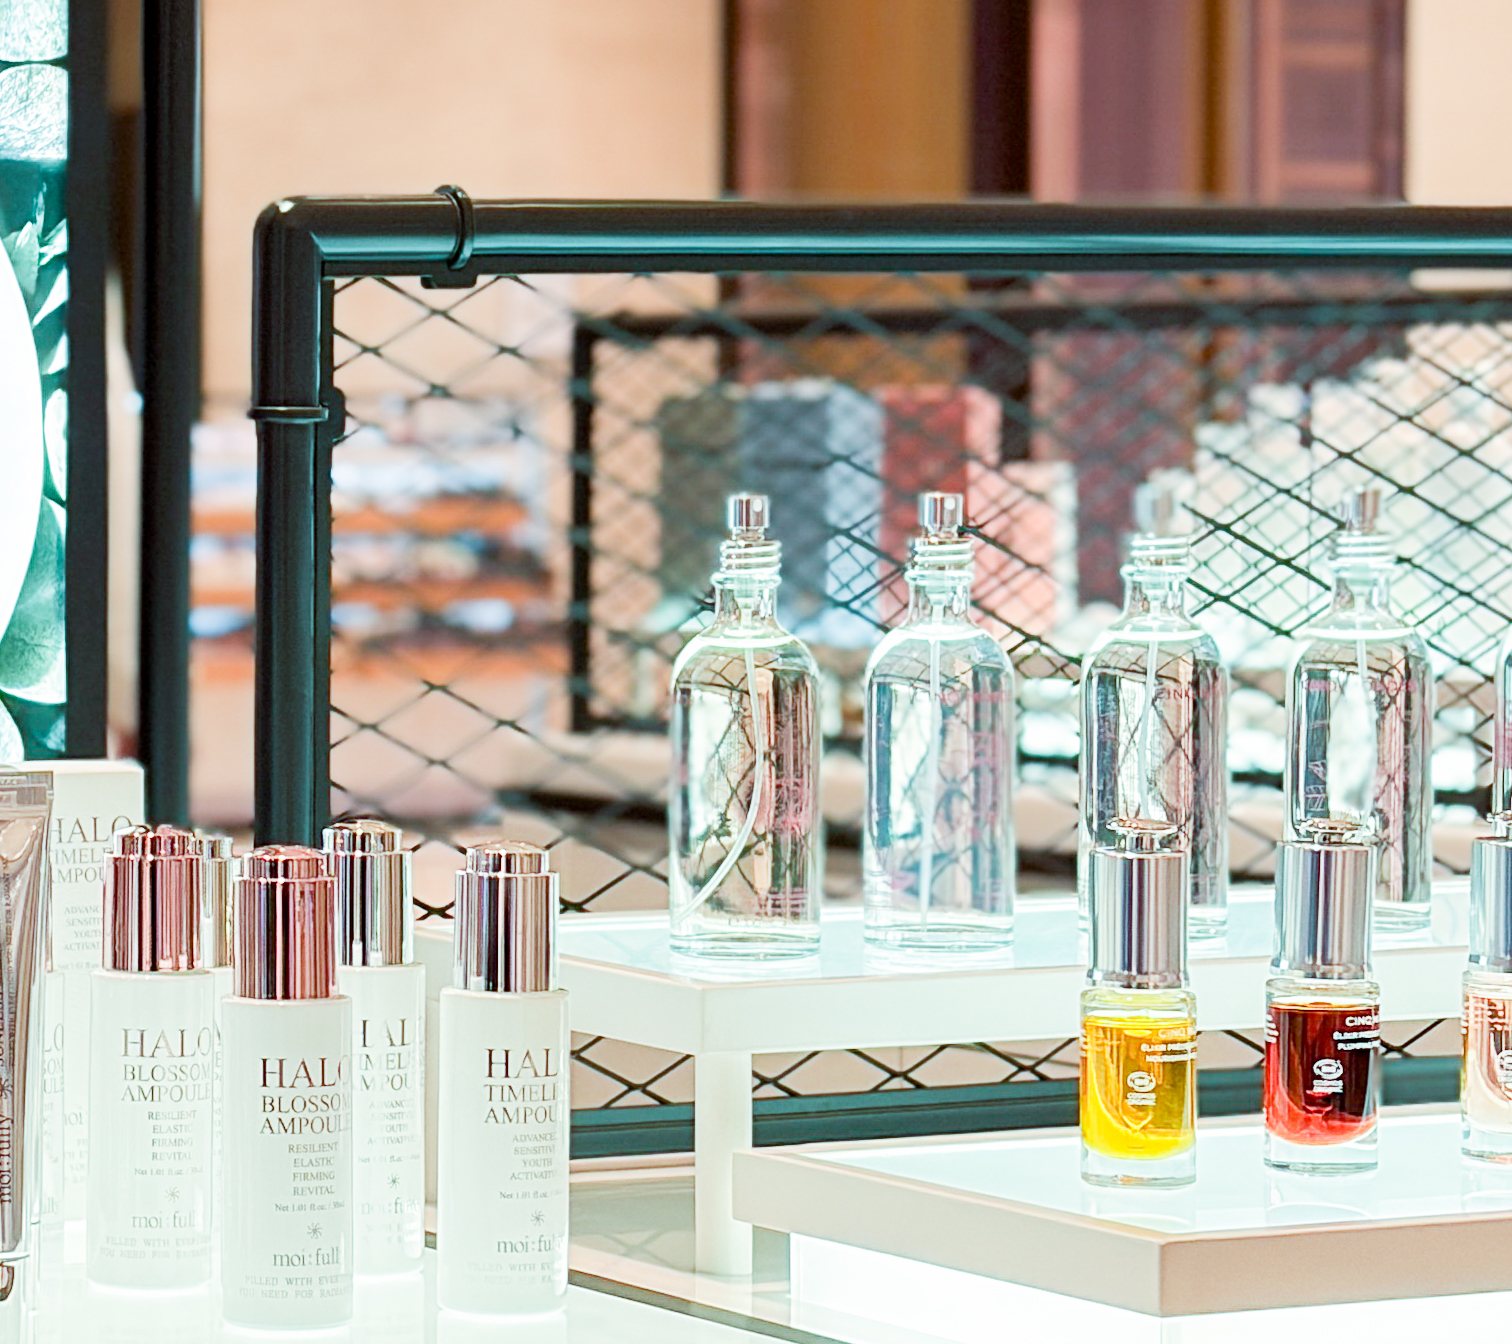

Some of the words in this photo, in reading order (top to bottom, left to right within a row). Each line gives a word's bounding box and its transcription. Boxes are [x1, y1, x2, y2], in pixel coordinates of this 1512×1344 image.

[121, 1026, 212, 1058] HALO
[484, 1048, 558, 1079] HAL
[483, 1082, 557, 1103] TIMEL
[147, 1109, 198, 1121] RESILIENT
[483, 1105, 557, 1125] AMPOU
[512, 1132, 557, 1143] ADVANCE
[288, 1141, 338, 1154] RESILIENT
[513, 1145, 556, 1156] SENSITIV
[292, 1171, 336, 1182] FIRMING
[292, 1185, 336, 1197] REVITAL
[272, 1246, 340, 1267] moi:full
